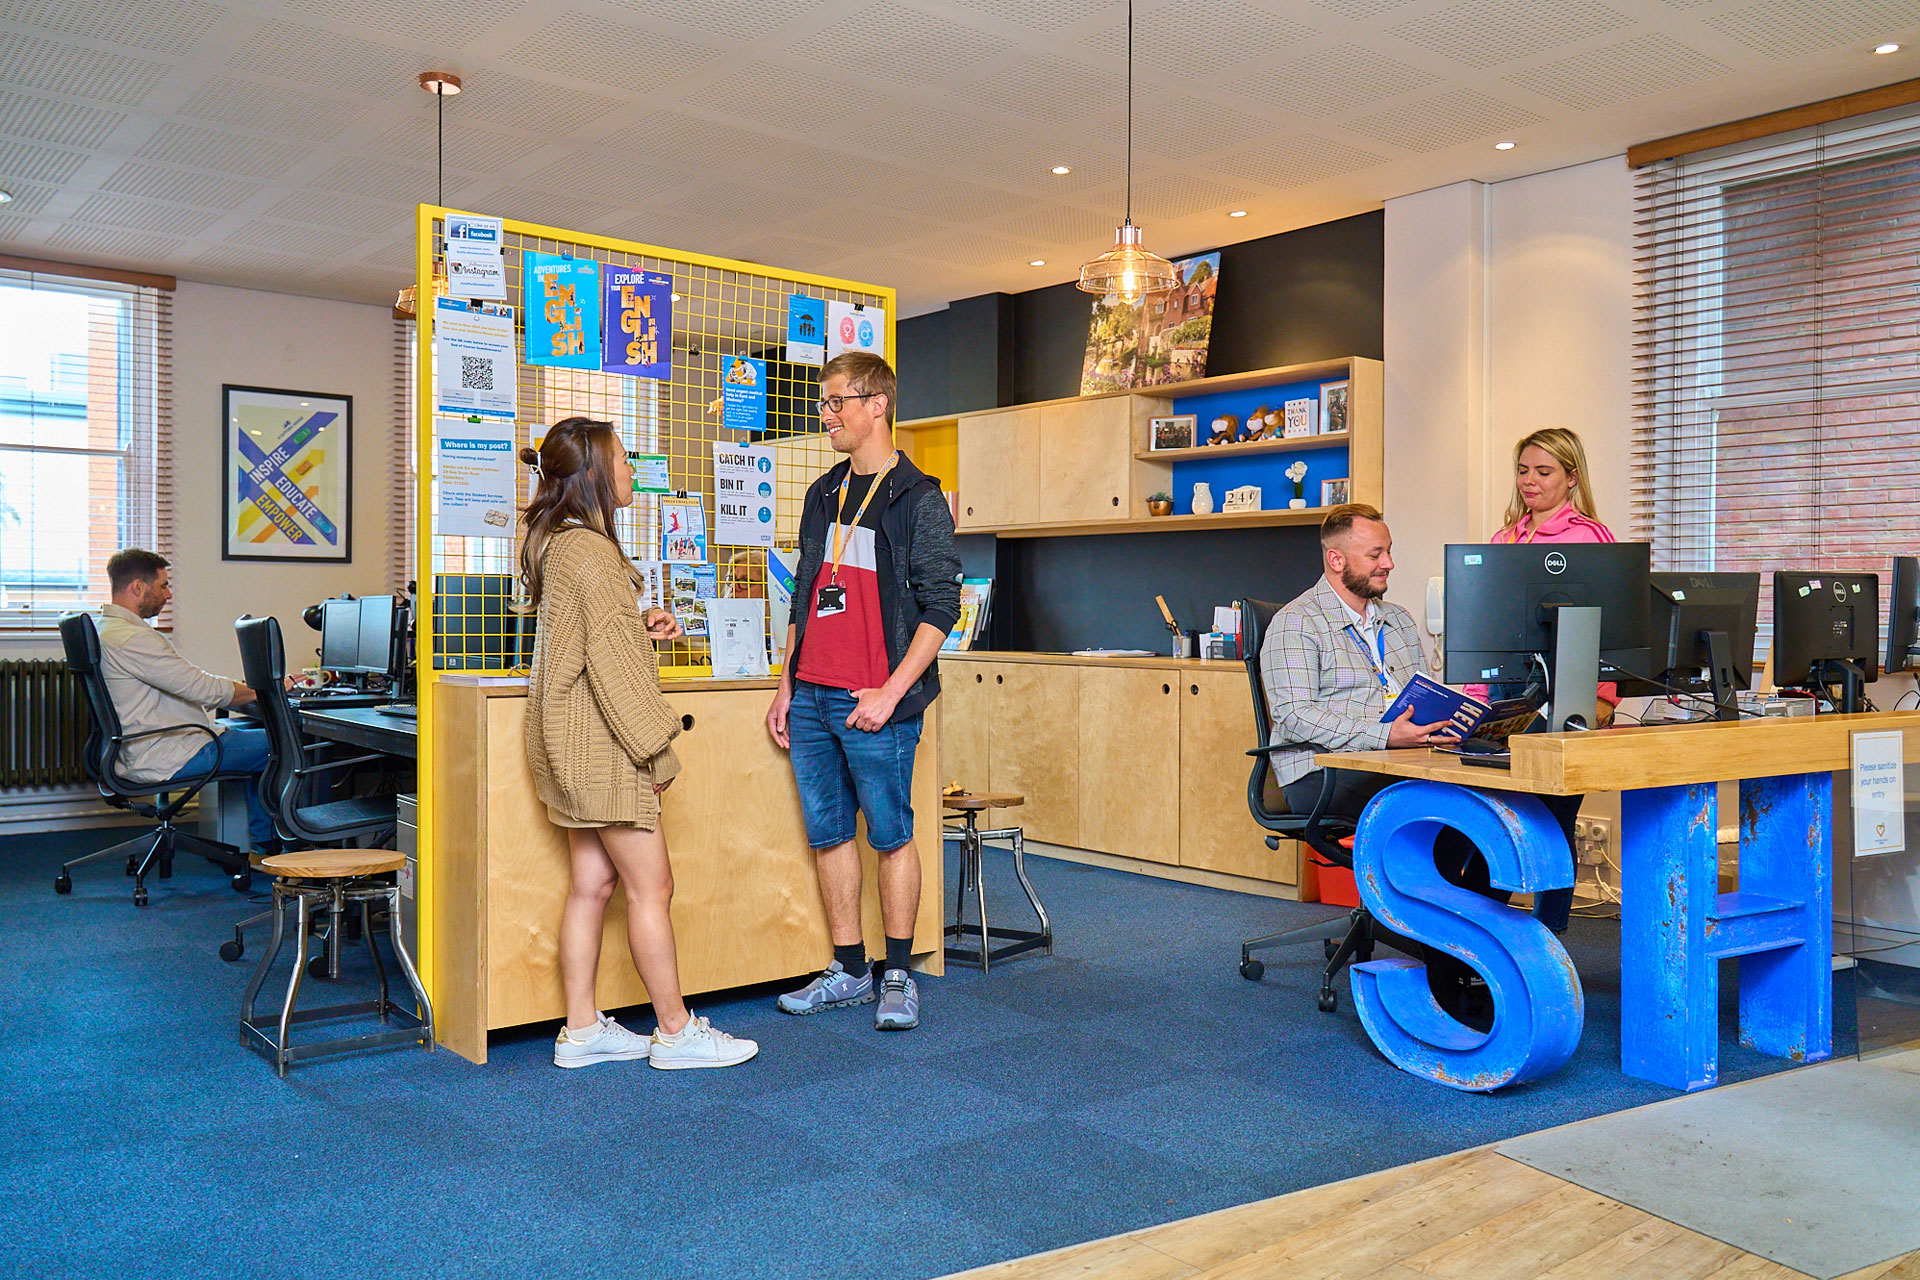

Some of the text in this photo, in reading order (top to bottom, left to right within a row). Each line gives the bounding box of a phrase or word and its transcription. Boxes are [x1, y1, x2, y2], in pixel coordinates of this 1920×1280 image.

[470, 230, 493, 239] facebook
[463, 265, 500, 279] Instagram
[534, 264, 572, 275] ADVENTURES
[614, 273, 645, 285] EXPLORE
[1287, 415, 1307, 428] YOU
[477, 442, 487, 450] my
[489, 442, 509, 450] post?
[249, 446, 290, 485] INSPIRE
[719, 453, 755, 467] CATCH IT
[720, 478, 744, 491] BIN IT
[275, 475, 318, 519] EDUCATE
[720, 503, 747, 516] KILL IT
[256, 493, 304, 542] EMPOWER
[1547, 559, 1565, 567] DELL
[1437, 701, 1484, 740] HELL
[1860, 761, 1897, 771] Please sanitize
[1860, 776, 1896, 788] your hands on
[1871, 791, 1885, 800] entry
